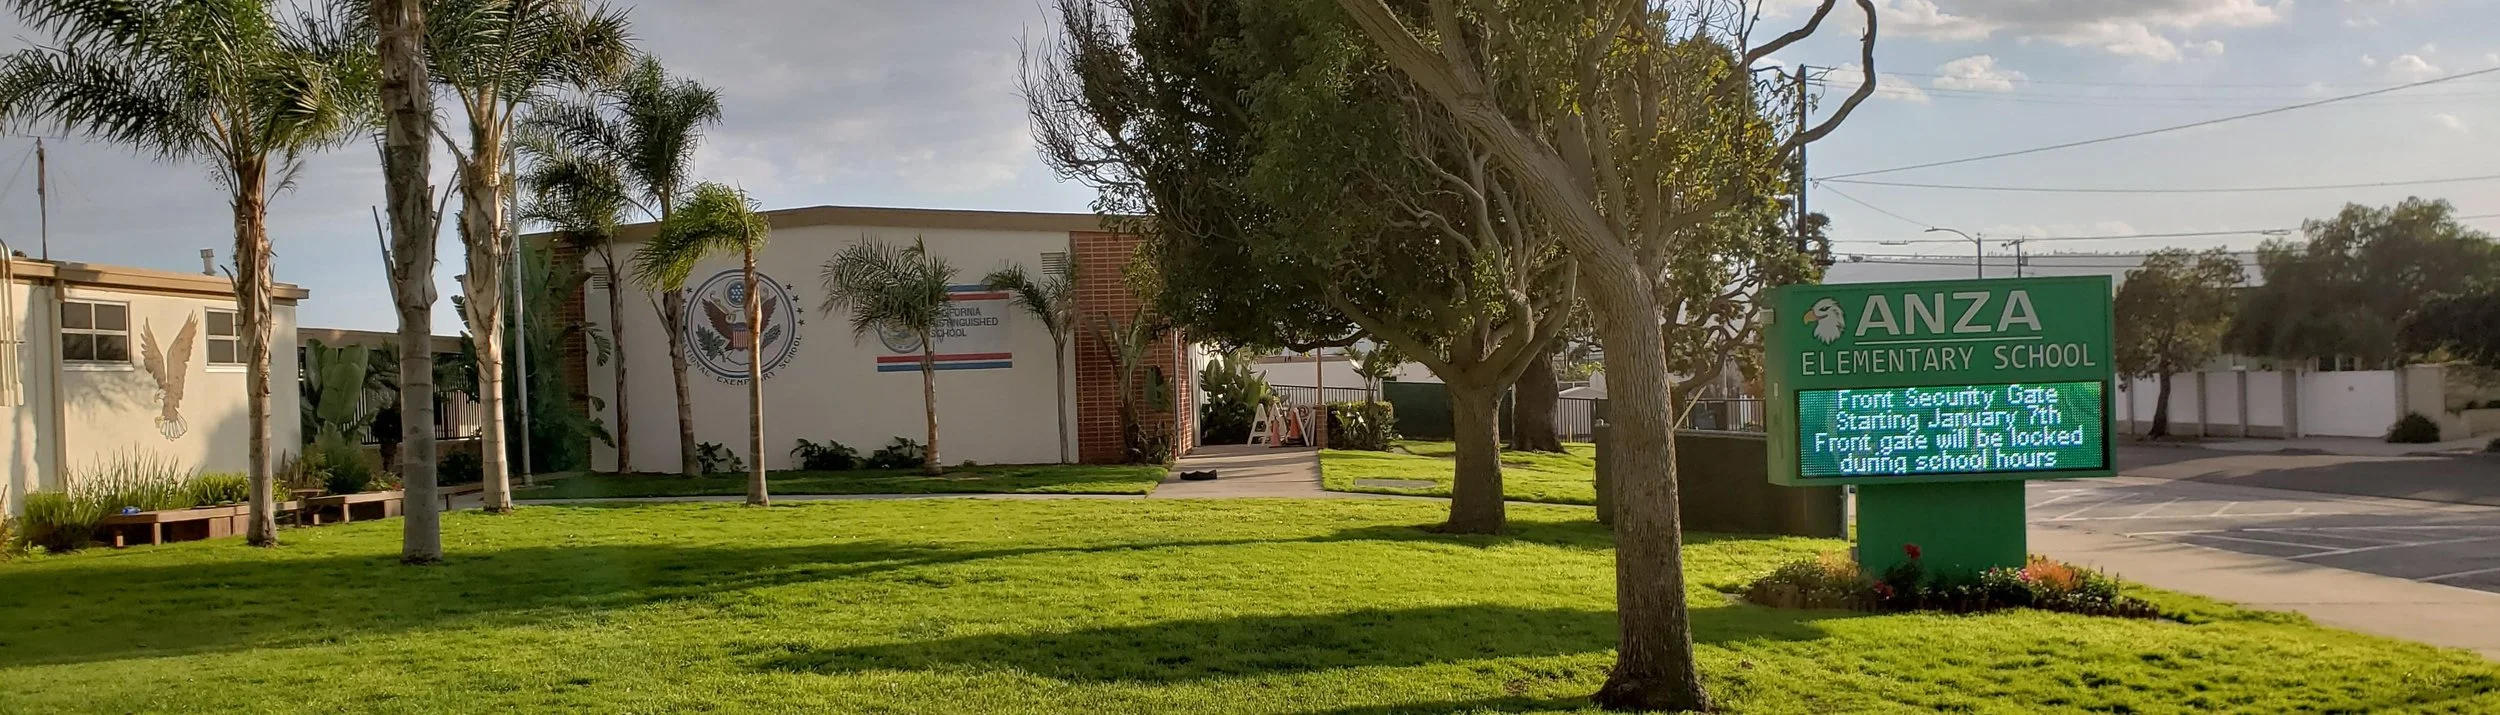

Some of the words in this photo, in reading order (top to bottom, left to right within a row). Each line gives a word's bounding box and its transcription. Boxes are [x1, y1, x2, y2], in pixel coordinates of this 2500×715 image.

[1854, 289, 2043, 337] ANZA
[930, 328, 967, 338] SCHOOL
[683, 337, 711, 376] ATIONAL
[716, 371, 775, 386] EXEMPRY
[778, 335, 802, 369] SCHOOL
[1801, 346, 1974, 376] ELEMENTARY
[1993, 342, 2096, 370] SCHOOL
[1837, 389, 1895, 409] Front
[1905, 385, 1996, 411] Security
[2007, 384, 2058, 405] Gate
[1836, 409, 1919, 434] Starting
[1928, 407, 2018, 431] January
[2028, 404, 2062, 425] 7th
[1815, 432, 1872, 452] Front
[1877, 433, 1928, 456] gate
[1936, 427, 1968, 449] will
[1975, 427, 2003, 448] be
[2010, 424, 2084, 447] locked
[1840, 452, 1907, 474] during
[1915, 448, 1988, 471] school
[1995, 448, 2058, 469] hours
